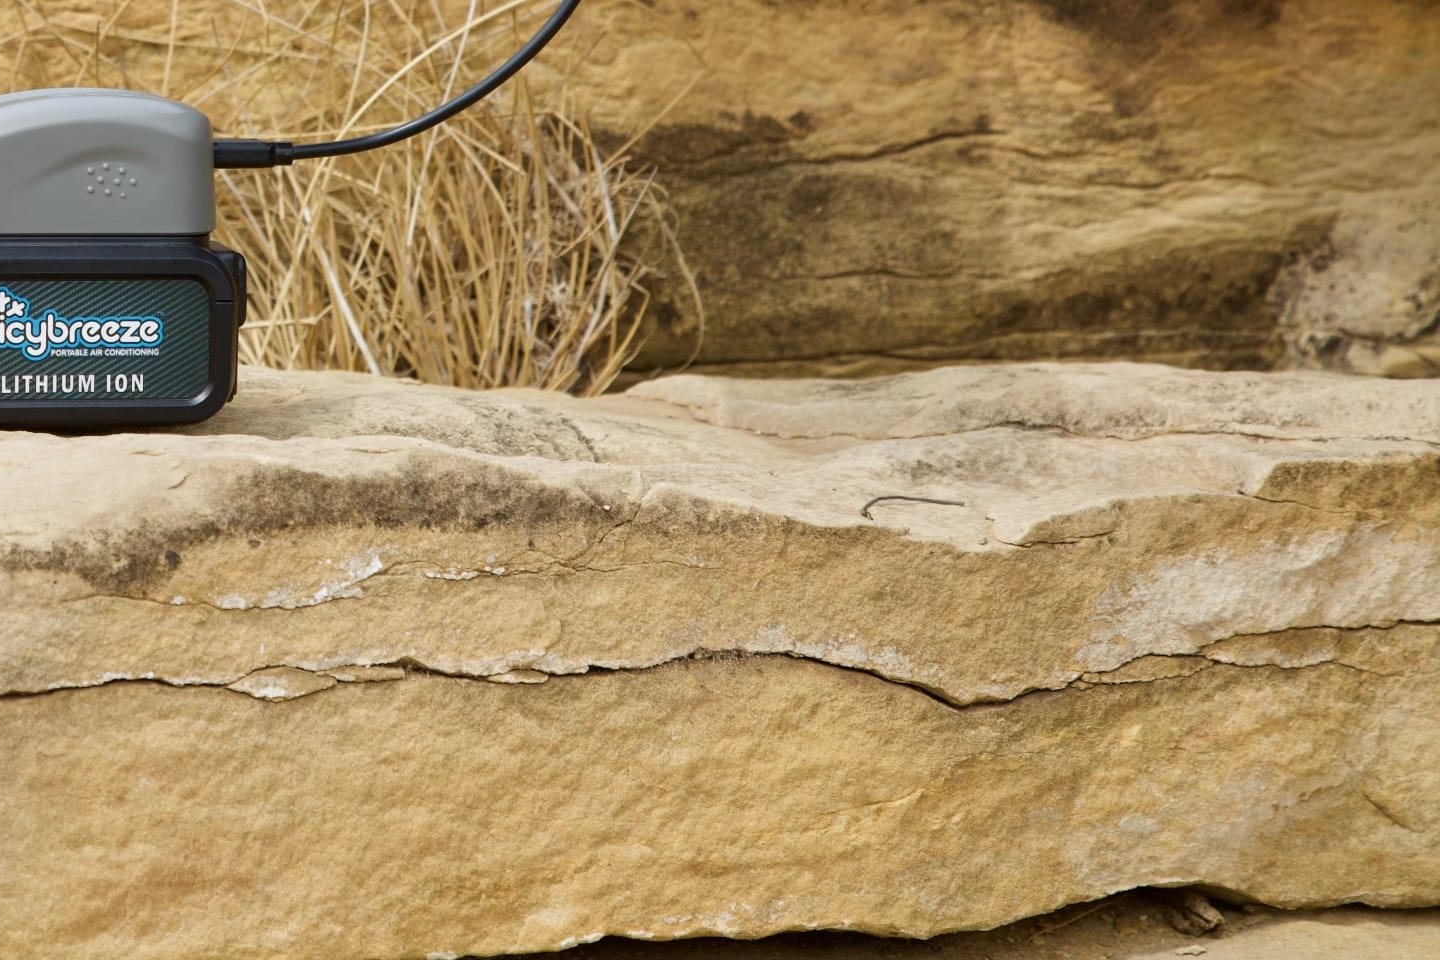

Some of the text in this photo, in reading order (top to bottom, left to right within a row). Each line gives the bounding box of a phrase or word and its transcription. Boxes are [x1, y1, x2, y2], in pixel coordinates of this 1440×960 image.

[51, 348, 160, 357] PORTABLE AIR CONDITIONING
[1, 373, 144, 394] LITHIUM ION
